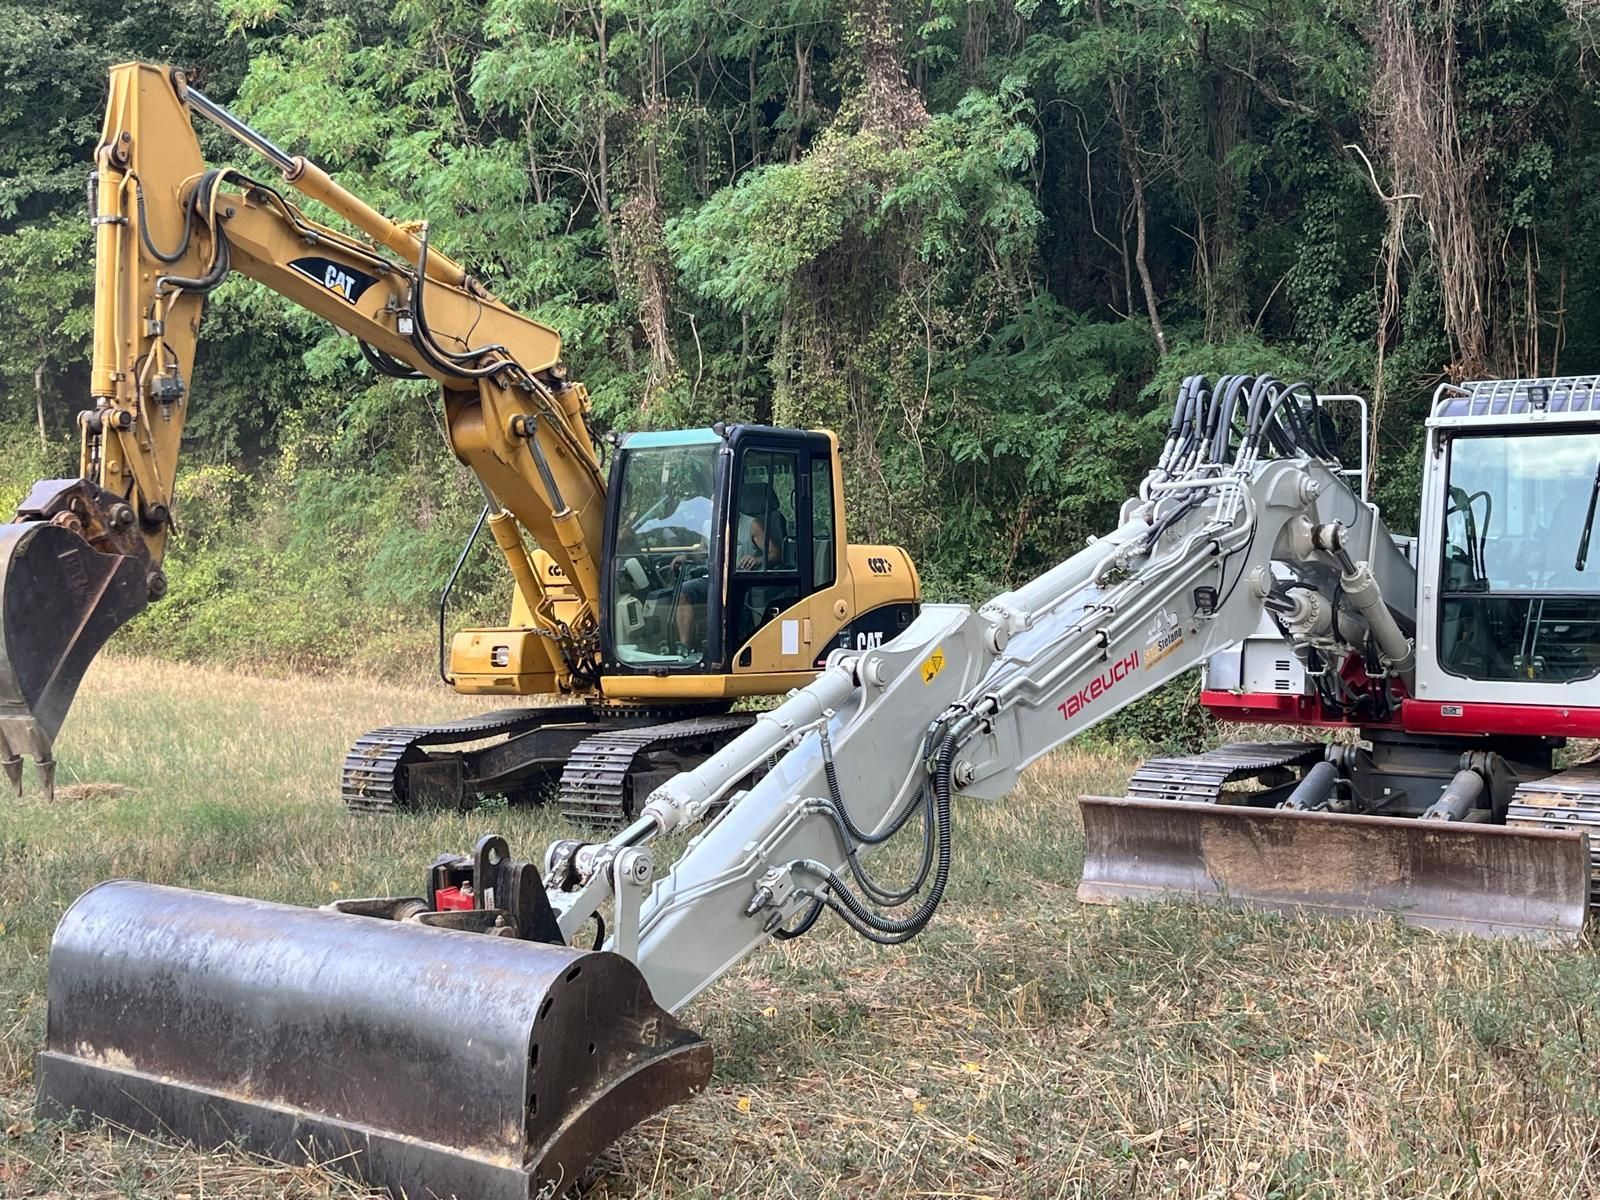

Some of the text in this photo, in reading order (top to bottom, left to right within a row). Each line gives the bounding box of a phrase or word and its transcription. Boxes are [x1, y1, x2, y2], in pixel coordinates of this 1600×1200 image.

[324, 264, 356, 300] CAT
[856, 631, 884, 653] CAT
[1057, 650, 1140, 721] TAKEUCHI
